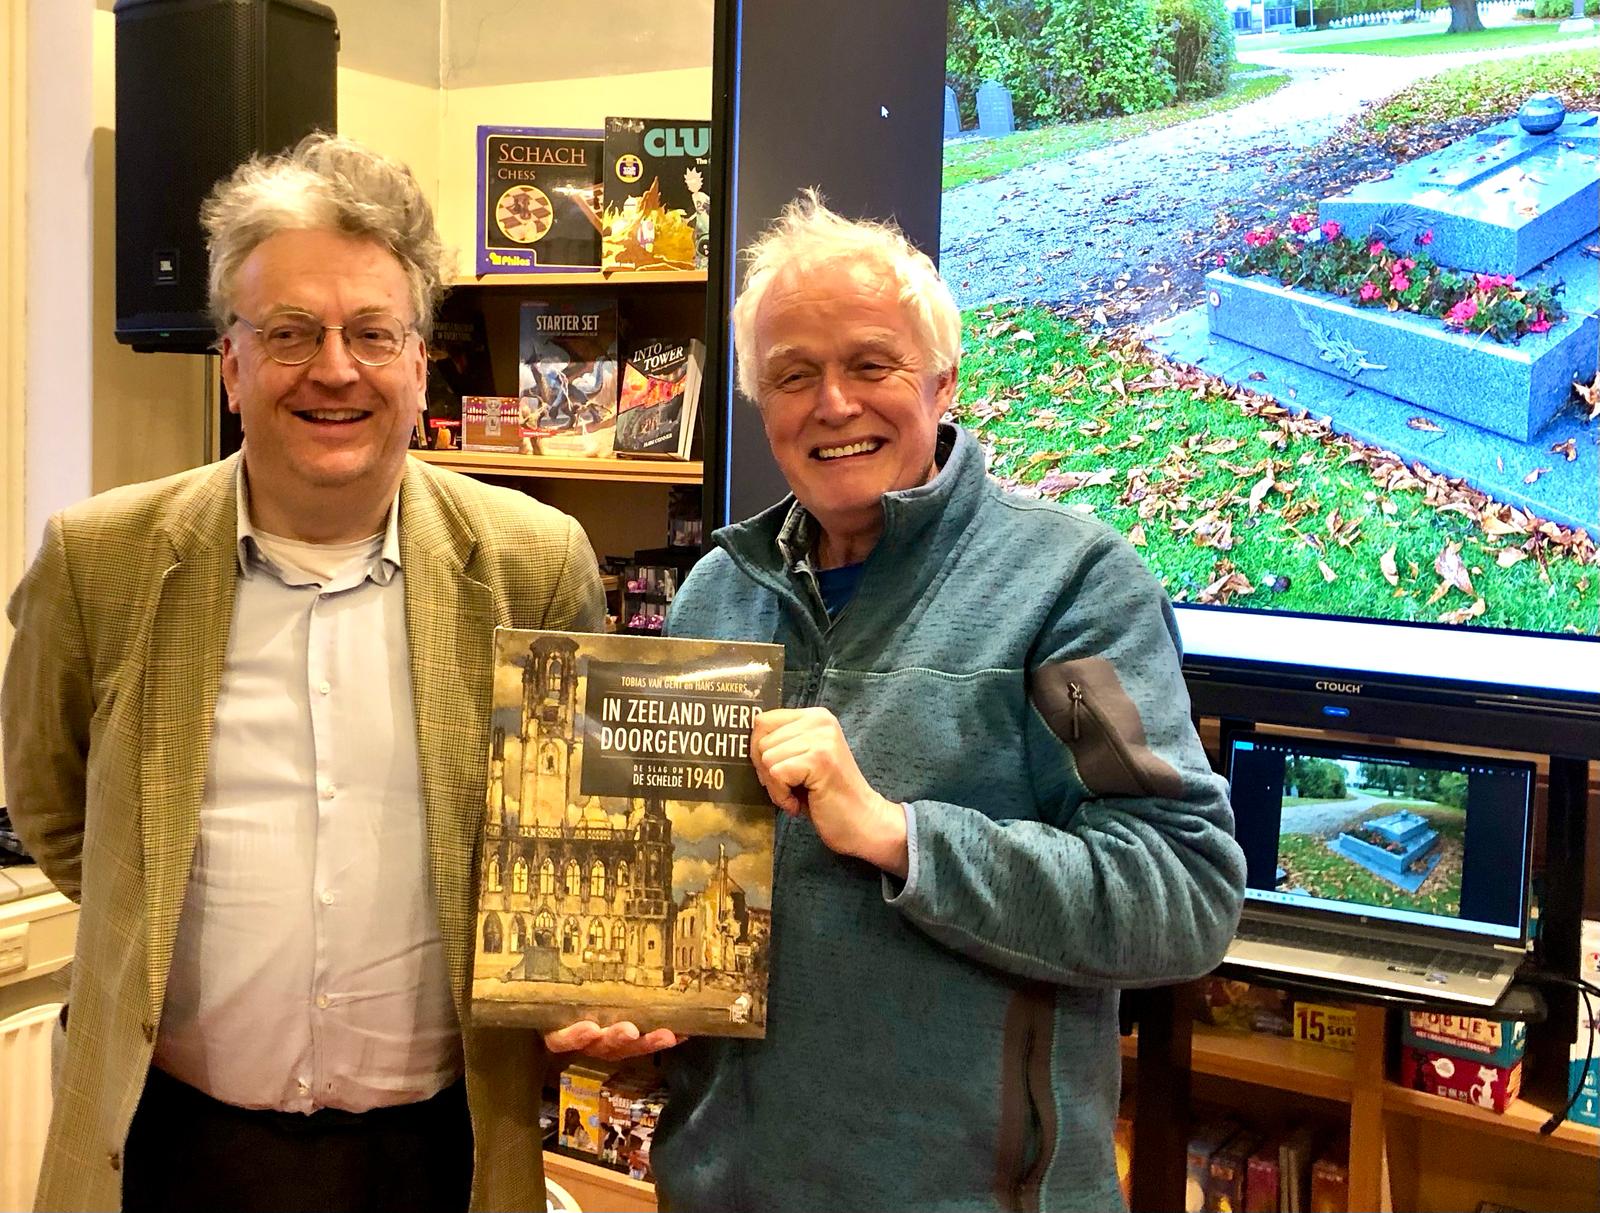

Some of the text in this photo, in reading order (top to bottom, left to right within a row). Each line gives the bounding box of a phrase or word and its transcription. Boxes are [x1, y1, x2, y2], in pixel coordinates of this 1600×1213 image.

[643, 127, 711, 157] CLU
[536, 315, 600, 331] STARTER SET
[632, 343, 662, 363] INTO
[644, 346, 684, 371] TOWER
[621, 675, 647, 688] TOBIAS
[648, 677, 661, 689] VAN
[695, 680, 714, 692] HANS
[717, 682, 748, 693] SAKKERS
[1315, 681, 1361, 694] CTOUCH
[602, 698, 621, 722] IN
[626, 699, 706, 726] ZEELAND
[600, 726, 749, 759] DOORGEVOCHTE
[632, 767, 725, 790] DE SCHELDE 1940
[633, 764, 643, 772] DE
[648, 765, 668, 774] SLAG
[1297, 1008, 1325, 1042] 15
